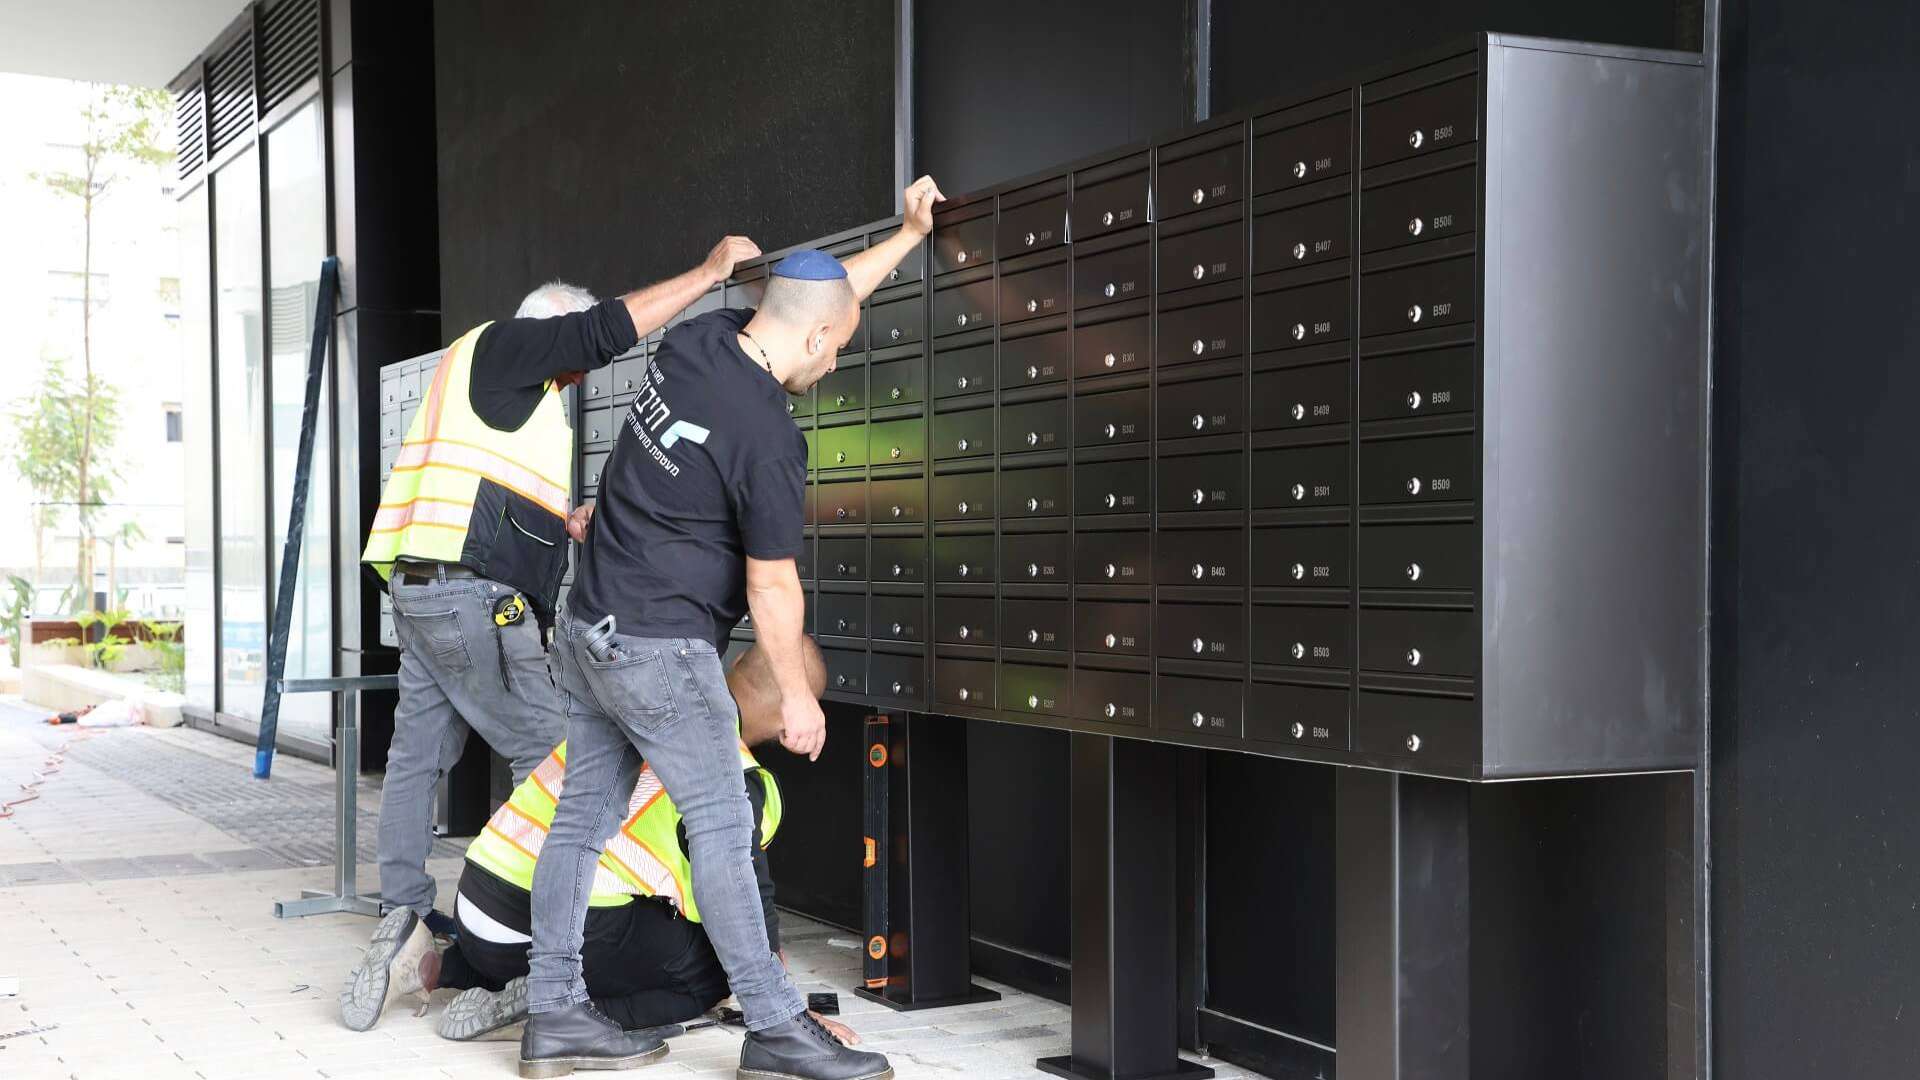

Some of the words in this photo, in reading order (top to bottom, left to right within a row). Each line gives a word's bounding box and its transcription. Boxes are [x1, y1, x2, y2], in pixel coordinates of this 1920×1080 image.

[1435, 126, 1453, 140] B505
[1316, 240, 1331, 252] B407
[1433, 304, 1451, 316] B507
[1315, 322, 1331, 333] B408
[1432, 391, 1450, 404] B508
[1313, 405, 1330, 416] B409
[648, 444, 680, 477] מעטפת
[1432, 479, 1450, 490] B509
[1314, 486, 1330, 496] B501
[1211, 566, 1226, 576] B403
[1313, 567, 1330, 576] B502
[1313, 647, 1330, 657] B503
[1313, 727, 1329, 738] B504
